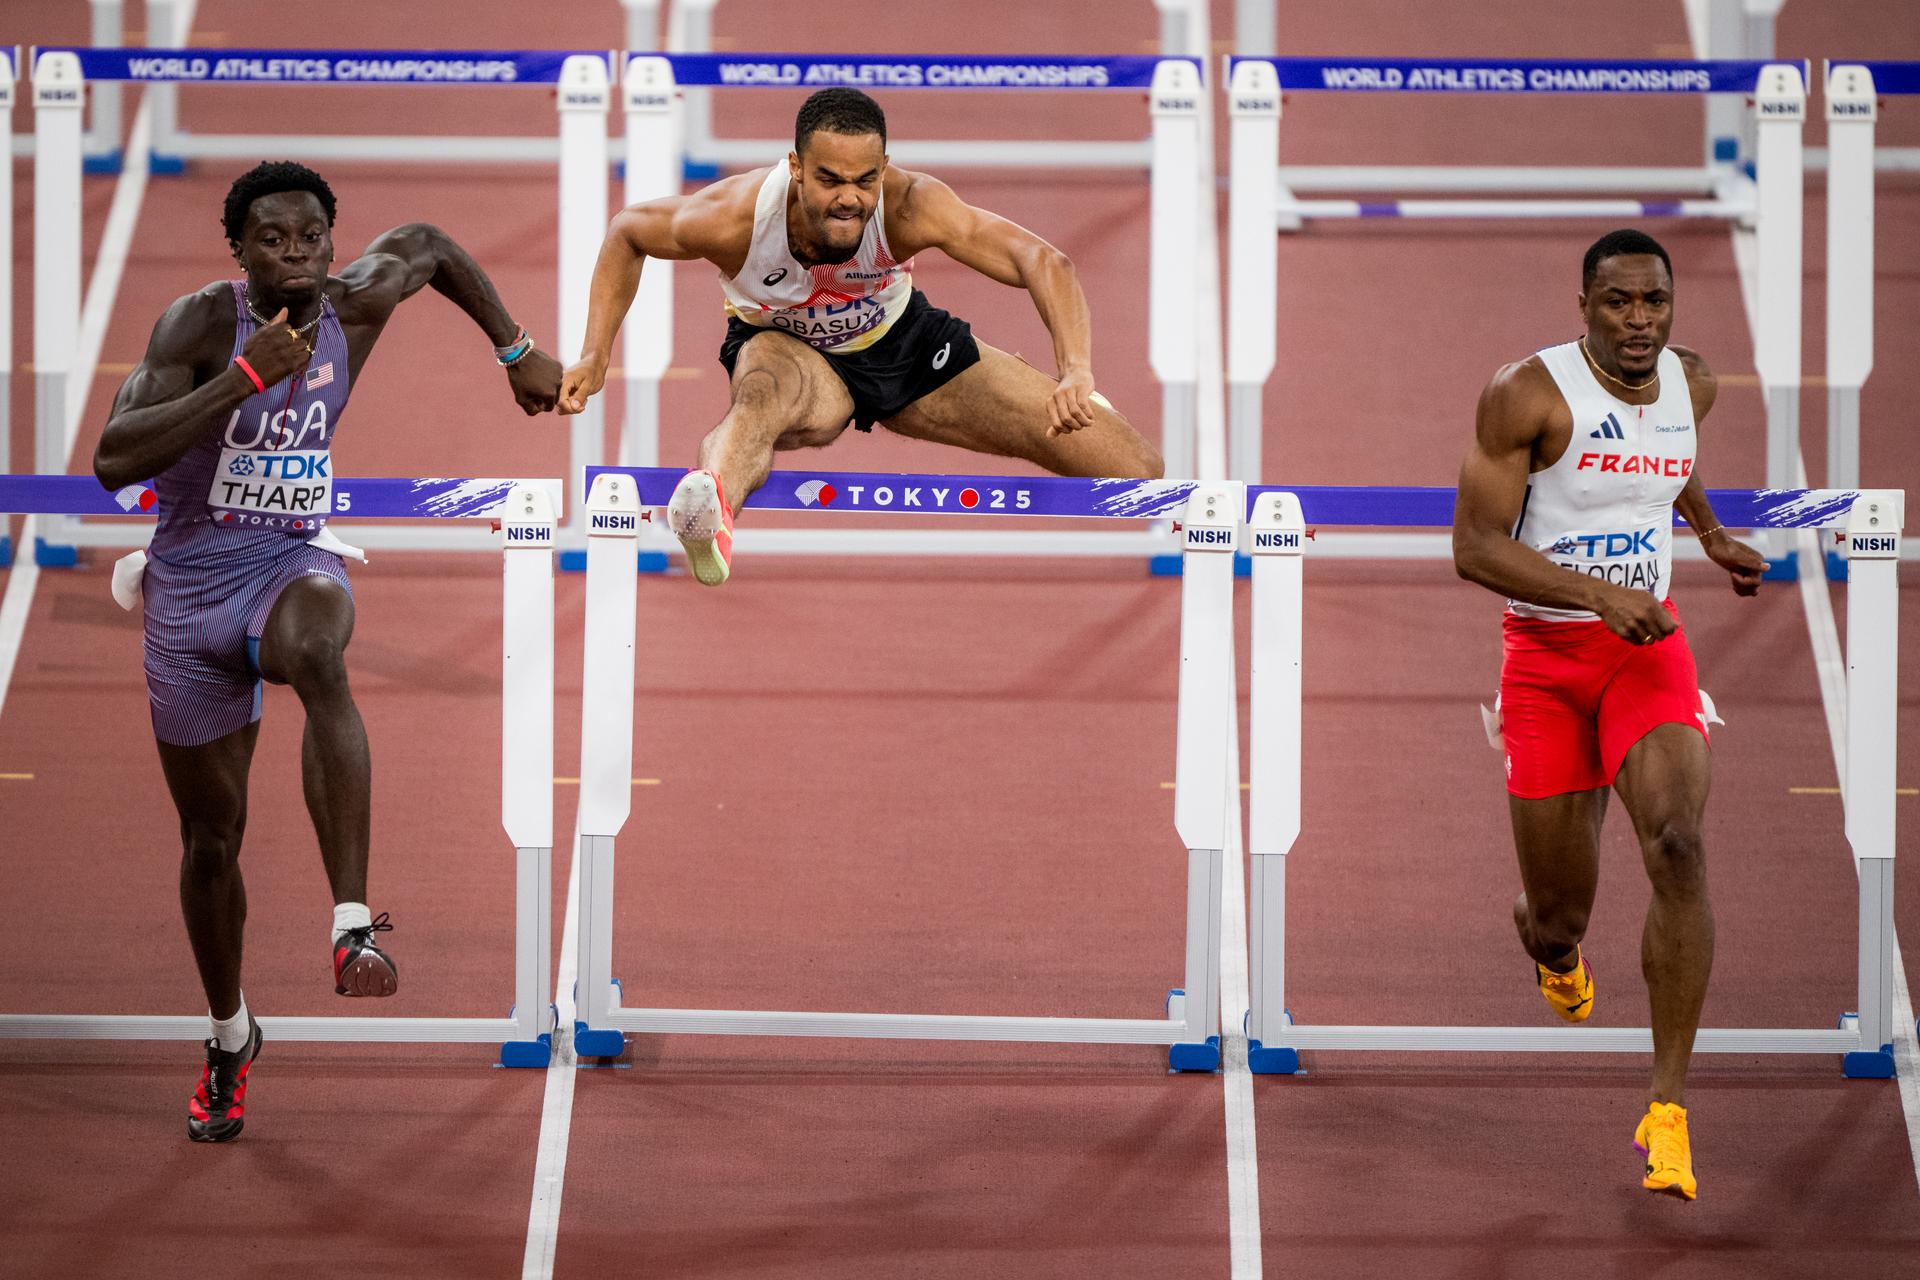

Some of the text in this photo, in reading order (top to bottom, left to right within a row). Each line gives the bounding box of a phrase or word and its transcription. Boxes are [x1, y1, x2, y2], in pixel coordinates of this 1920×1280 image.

[128, 59, 516, 81] WORLD ATHLETICS CHAMPIONSHIPS
[720, 64, 1108, 86] WORLD ATHLETICS CHAMPIONSHIPS
[1322, 68, 1710, 90] WORLD ATHLETICS CHAMPIONSHIPS
[845, 272, 883, 281] Allianz
[224, 400, 327, 451] USA
[257, 455, 329, 480] TDK
[1577, 453, 1692, 477] FRANCE
[222, 481, 326, 512] THARP
[592, 515, 635, 529] NISHI
[507, 527, 550, 540] NISHI
[1188, 530, 1231, 544] NISHI
[1256, 533, 1299, 547] NISHI
[1577, 528, 1656, 558] TDK
[1852, 538, 1896, 551] NISHI
